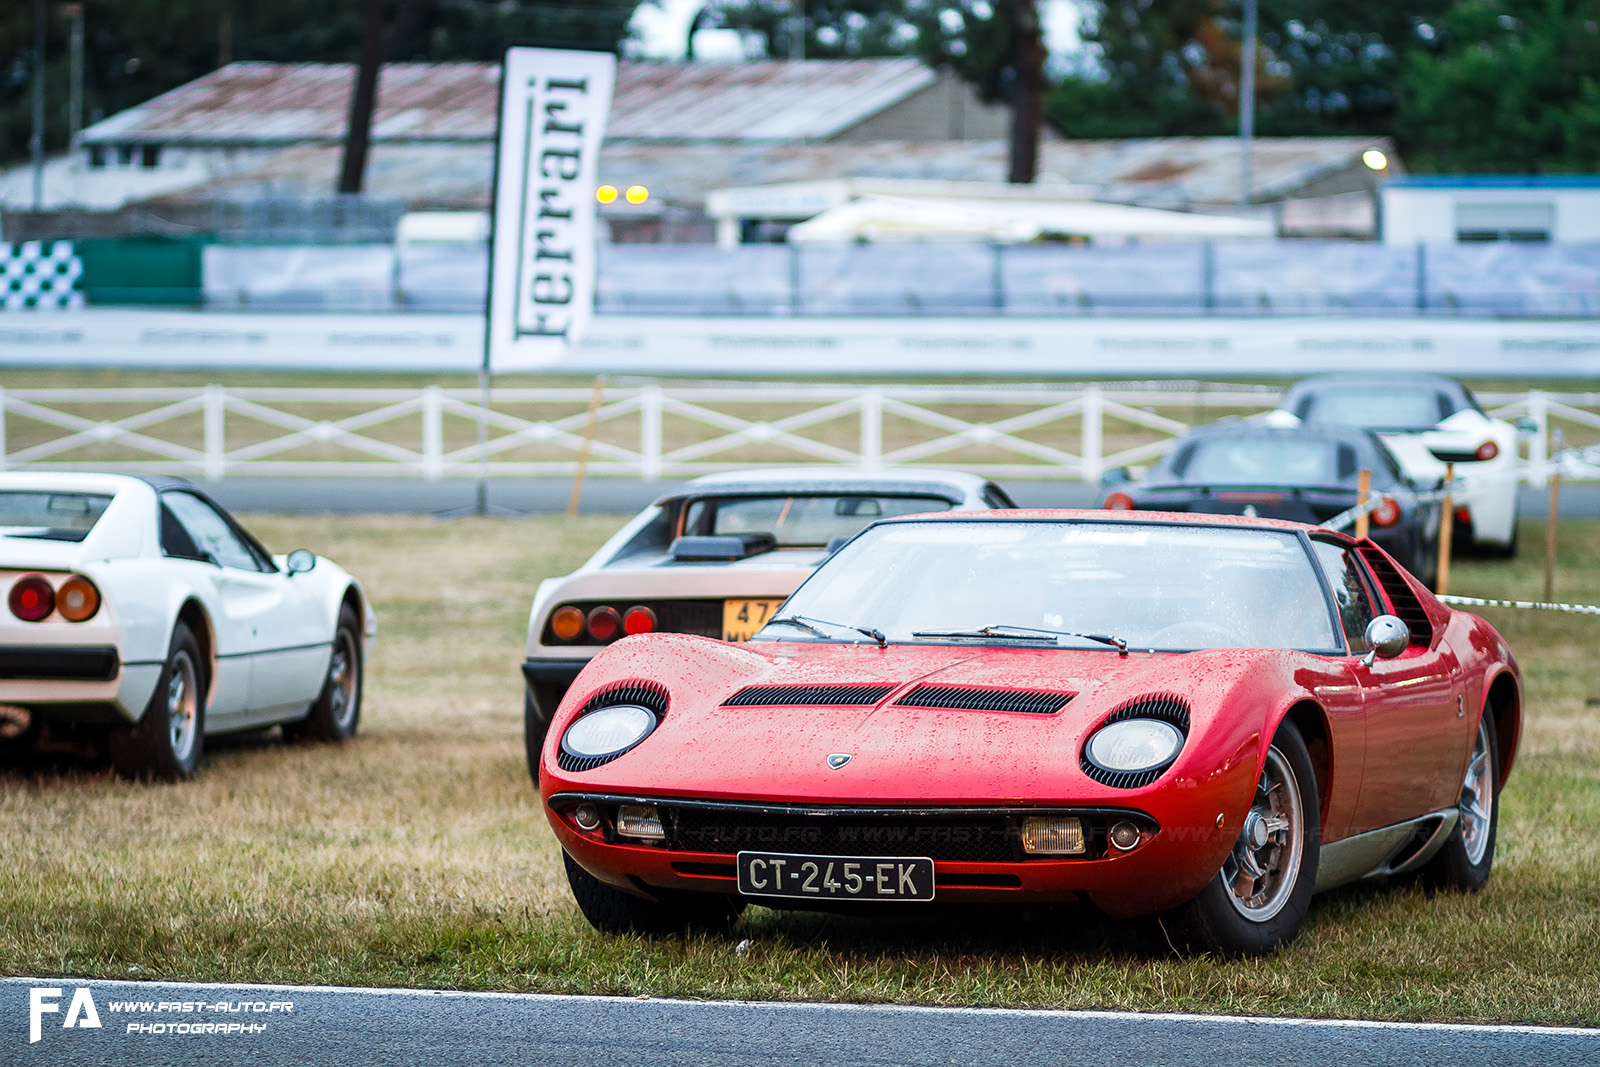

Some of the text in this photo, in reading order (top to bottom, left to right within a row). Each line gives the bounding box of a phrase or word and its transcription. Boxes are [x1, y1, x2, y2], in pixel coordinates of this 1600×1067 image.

[513, 74, 590, 343] Ferrari
[736, 602, 783, 623] 47
[749, 858, 918, 895] CT-245-EK
